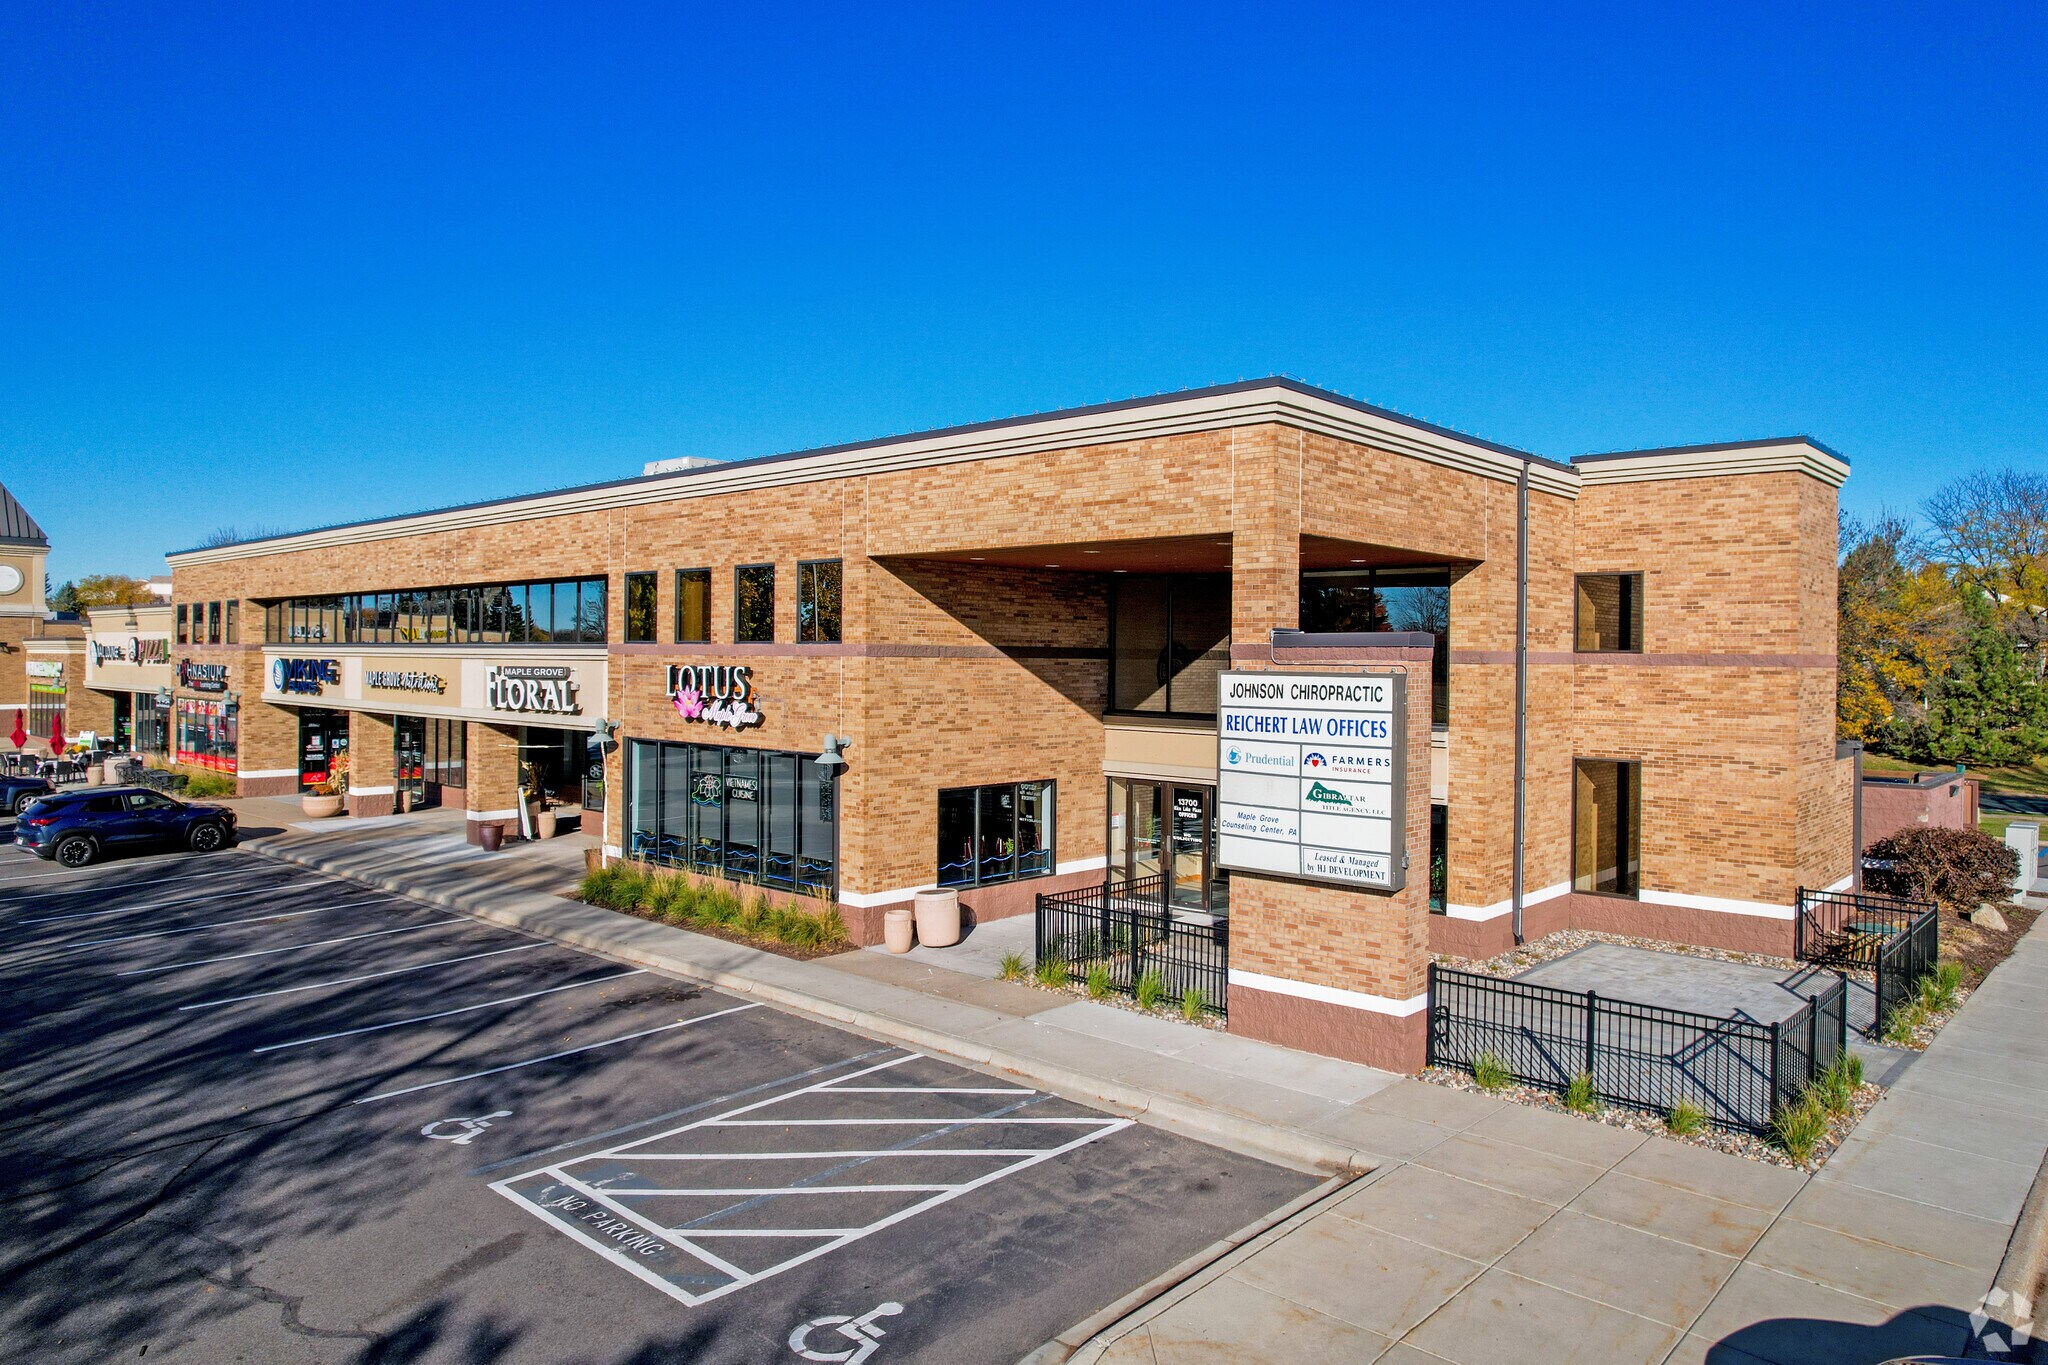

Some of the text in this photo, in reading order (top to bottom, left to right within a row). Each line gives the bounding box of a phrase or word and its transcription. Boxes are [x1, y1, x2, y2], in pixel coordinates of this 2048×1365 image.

[139, 640, 164, 660] PIZZA
[284, 658, 333, 681] VIKING
[504, 668, 563, 676] MAPLE GROVE
[364, 671, 382, 686] MAPLE
[383, 672, 400, 687] GROVE
[665, 665, 746, 700] LOTUS
[485, 665, 575, 712] FLORAL
[1229, 683, 1384, 703] JOHNSON CHIROPRACTIC
[701, 700, 758, 728] Maple Grove
[1226, 714, 1387, 739] REICHERT LAW OFFICES
[1245, 752, 1295, 767] Prudential
[1332, 755, 1391, 767] FARMERS
[1332, 766, 1371, 775] INSURANCE
[732, 788, 756, 801] CUISINE
[1177, 798, 1198, 807] 13700
[1312, 788, 1366, 803] GIBRALTAR
[1237, 812, 1279, 824] Maple Grove
[1322, 804, 1340, 812] TITLE
[1372, 808, 1385, 816] LLC
[1222, 820, 1297, 836] Counseling Center, PA
[1315, 852, 1379, 868] Leased & Managed
[1307, 862, 1386, 881] by HJ DEVELOPMENT
[554, 1195, 666, 1257] NO PARKING
